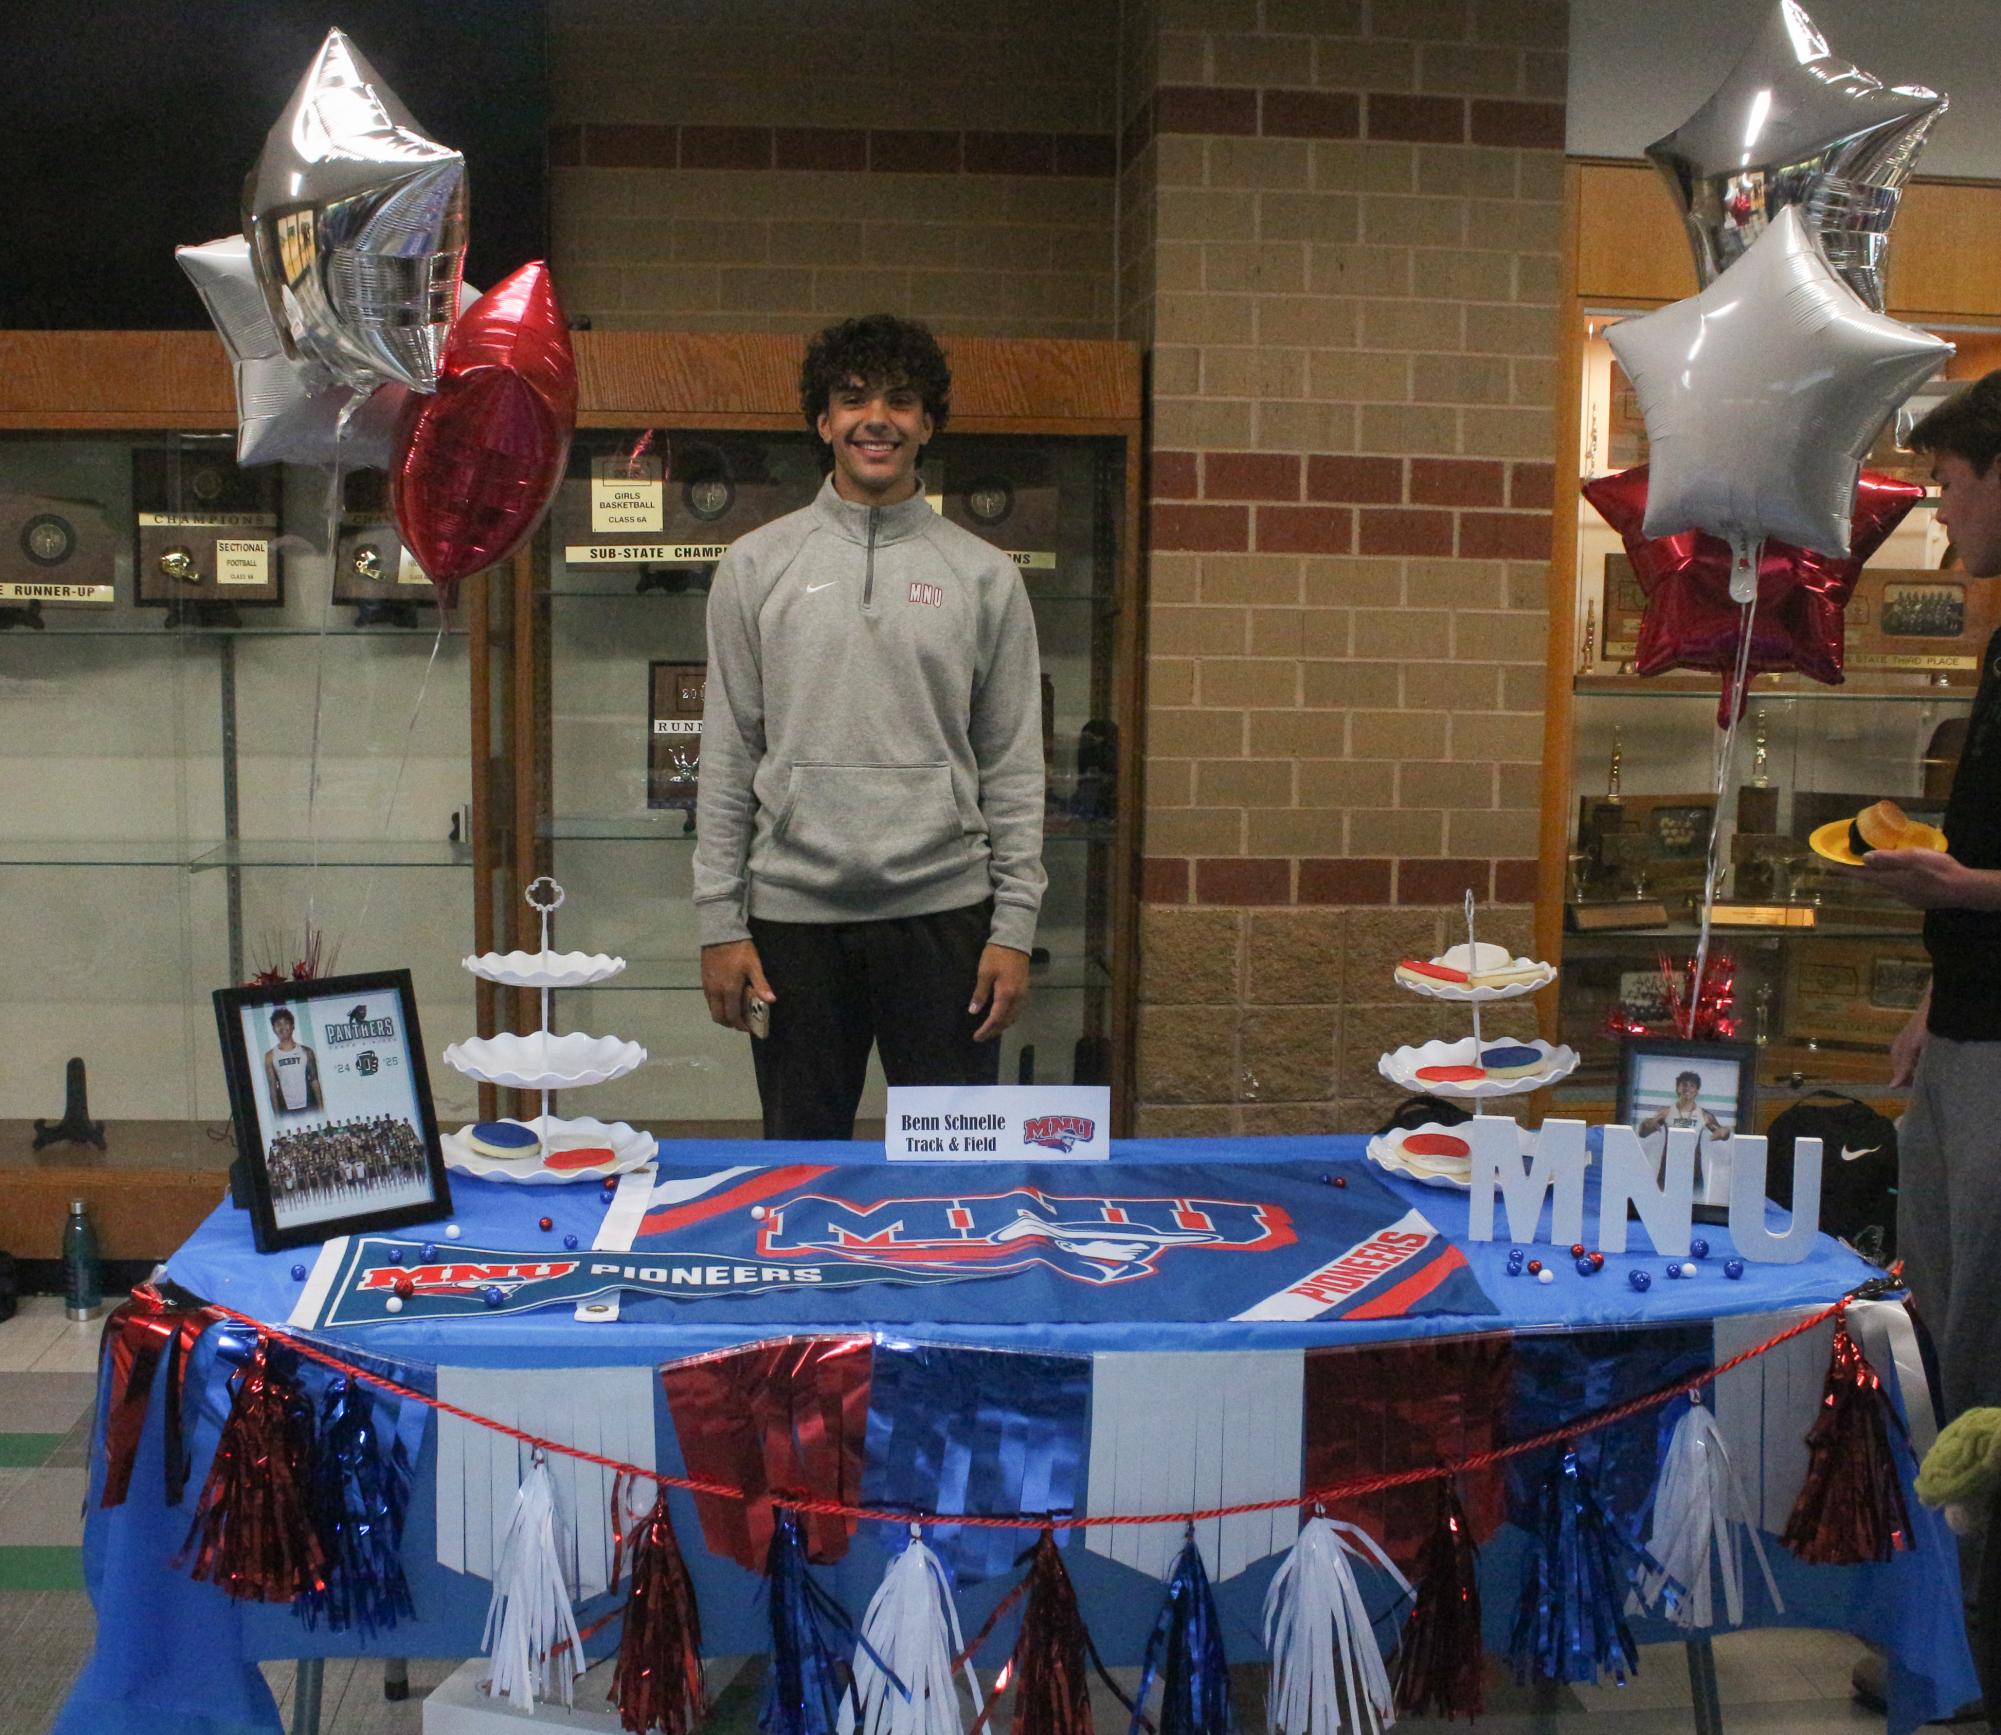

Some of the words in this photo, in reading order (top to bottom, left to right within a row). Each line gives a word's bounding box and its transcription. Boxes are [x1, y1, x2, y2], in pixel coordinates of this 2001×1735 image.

[614, 492, 641, 500] GIRLS
[599, 501, 655, 509] BASKETBALL
[154, 513, 266, 524] CHAMPIONS
[219, 543, 265, 552] SECTIONAL
[590, 548, 664, 559] SUB-STATE
[1007, 553, 1031, 564] NS
[14, 585, 95, 597] RUNNER-UP
[909, 582, 943, 608] MNU
[1855, 655, 1888, 664] STATE
[1927, 656, 1960, 666] PLACE
[325, 1017, 394, 1044] PANTHERS
[901, 1114, 940, 1131] Benn
[944, 1114, 1006, 1131] Schnelle
[1024, 1116, 1096, 1144] MNU
[906, 1137, 944, 1152] Track
[948, 1137, 960, 1151] &
[963, 1136, 997, 1152] Field
[1468, 1115, 1823, 1264] MNU
[757, 1190, 1298, 1256] MNU
[357, 1261, 580, 1290] MNU
[591, 1263, 823, 1285] PIONEERS
[1286, 1231, 1429, 1305] PIONEERS
